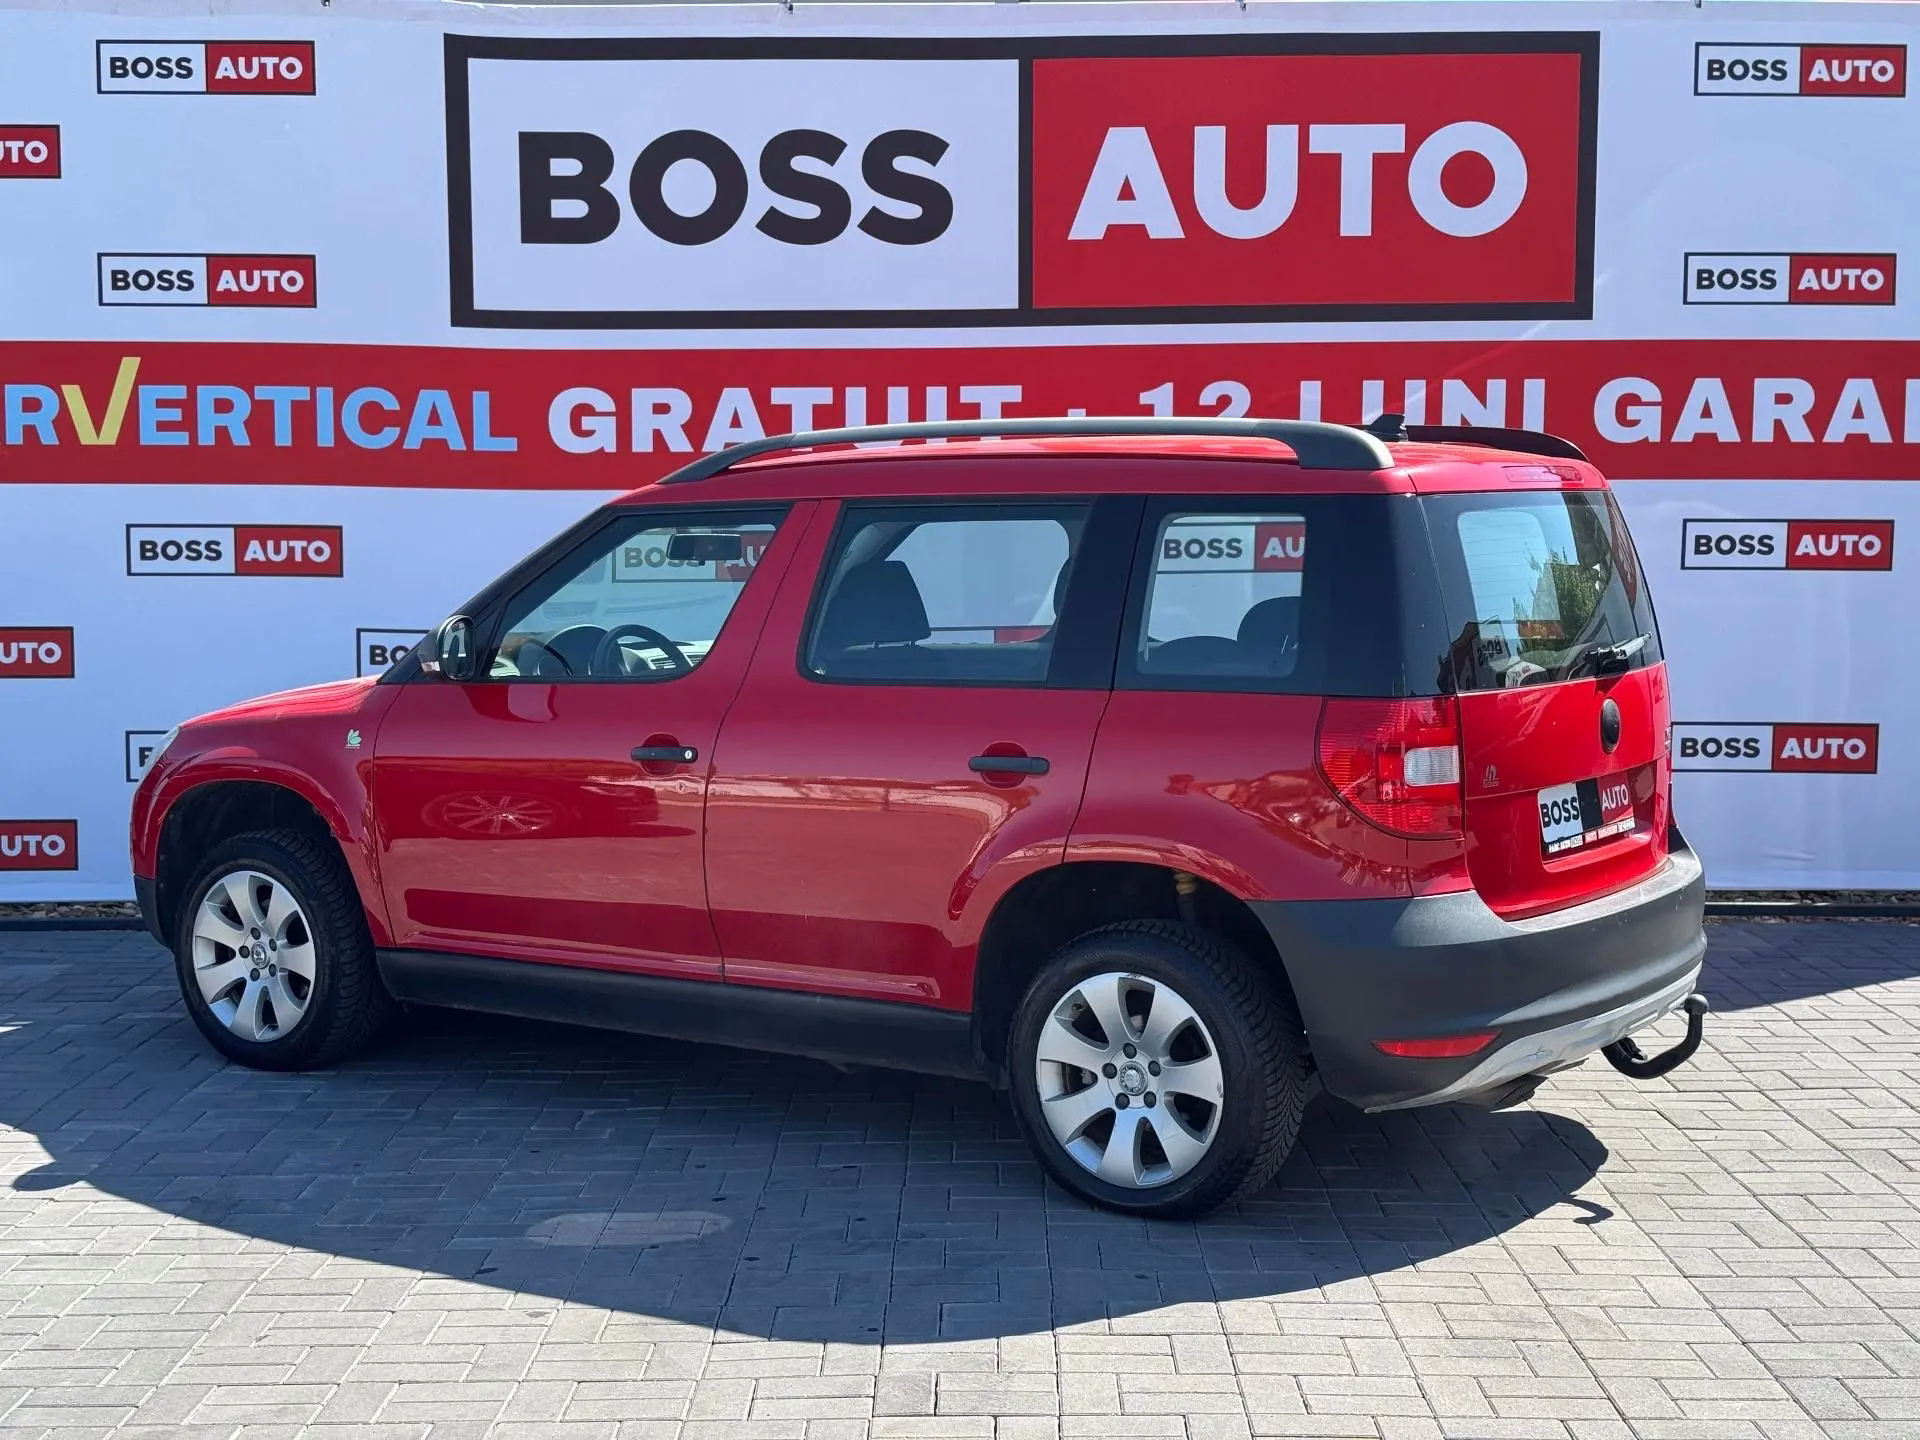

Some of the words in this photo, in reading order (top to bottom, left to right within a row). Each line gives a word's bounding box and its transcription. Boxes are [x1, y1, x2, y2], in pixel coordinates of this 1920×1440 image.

[110, 57, 193, 79] BOSS
[215, 57, 302, 79] AUTO
[1707, 59, 1787, 81] BOSS
[1809, 60, 1894, 82] AUTO
[0, 141, 48, 163] TO
[519, 129, 953, 245] BOSS
[1068, 121, 1527, 240] AUTO
[111, 270, 194, 291] BOSS
[217, 270, 303, 292] AUTO
[1697, 269, 1777, 290] BOSS
[1798, 269, 1884, 290] AUTO
[140, 540, 222, 561] BOSS
[244, 540, 330, 562] AUTO
[1164, 538, 1243, 559] BOSS
[1694, 535, 1774, 555] BOSS
[1795, 535, 1881, 556] AUTO
[1681, 738, 1760, 758] BOSS
[1781, 738, 1866, 759] AUTO
[1540, 796, 1580, 828] BOSS
[1602, 784, 1629, 811] AUTO
